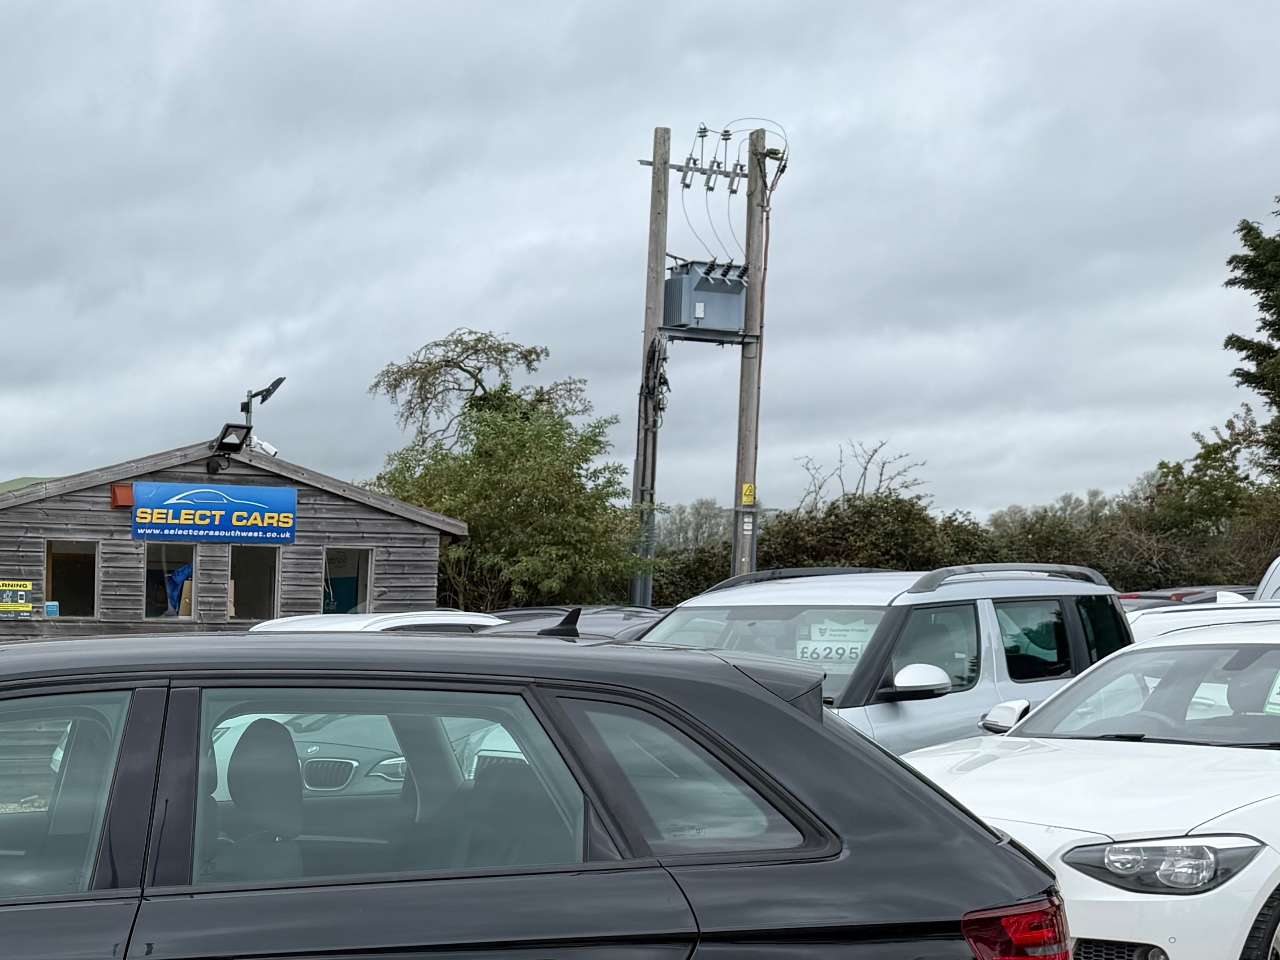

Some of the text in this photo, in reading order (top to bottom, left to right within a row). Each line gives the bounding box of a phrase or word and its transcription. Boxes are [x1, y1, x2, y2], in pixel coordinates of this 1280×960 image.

[135, 508, 294, 528] SELECT CARS
[137, 528, 291, 538] www.selectcarssouthwest.co.uk
[800, 646, 860, 660] £6295
